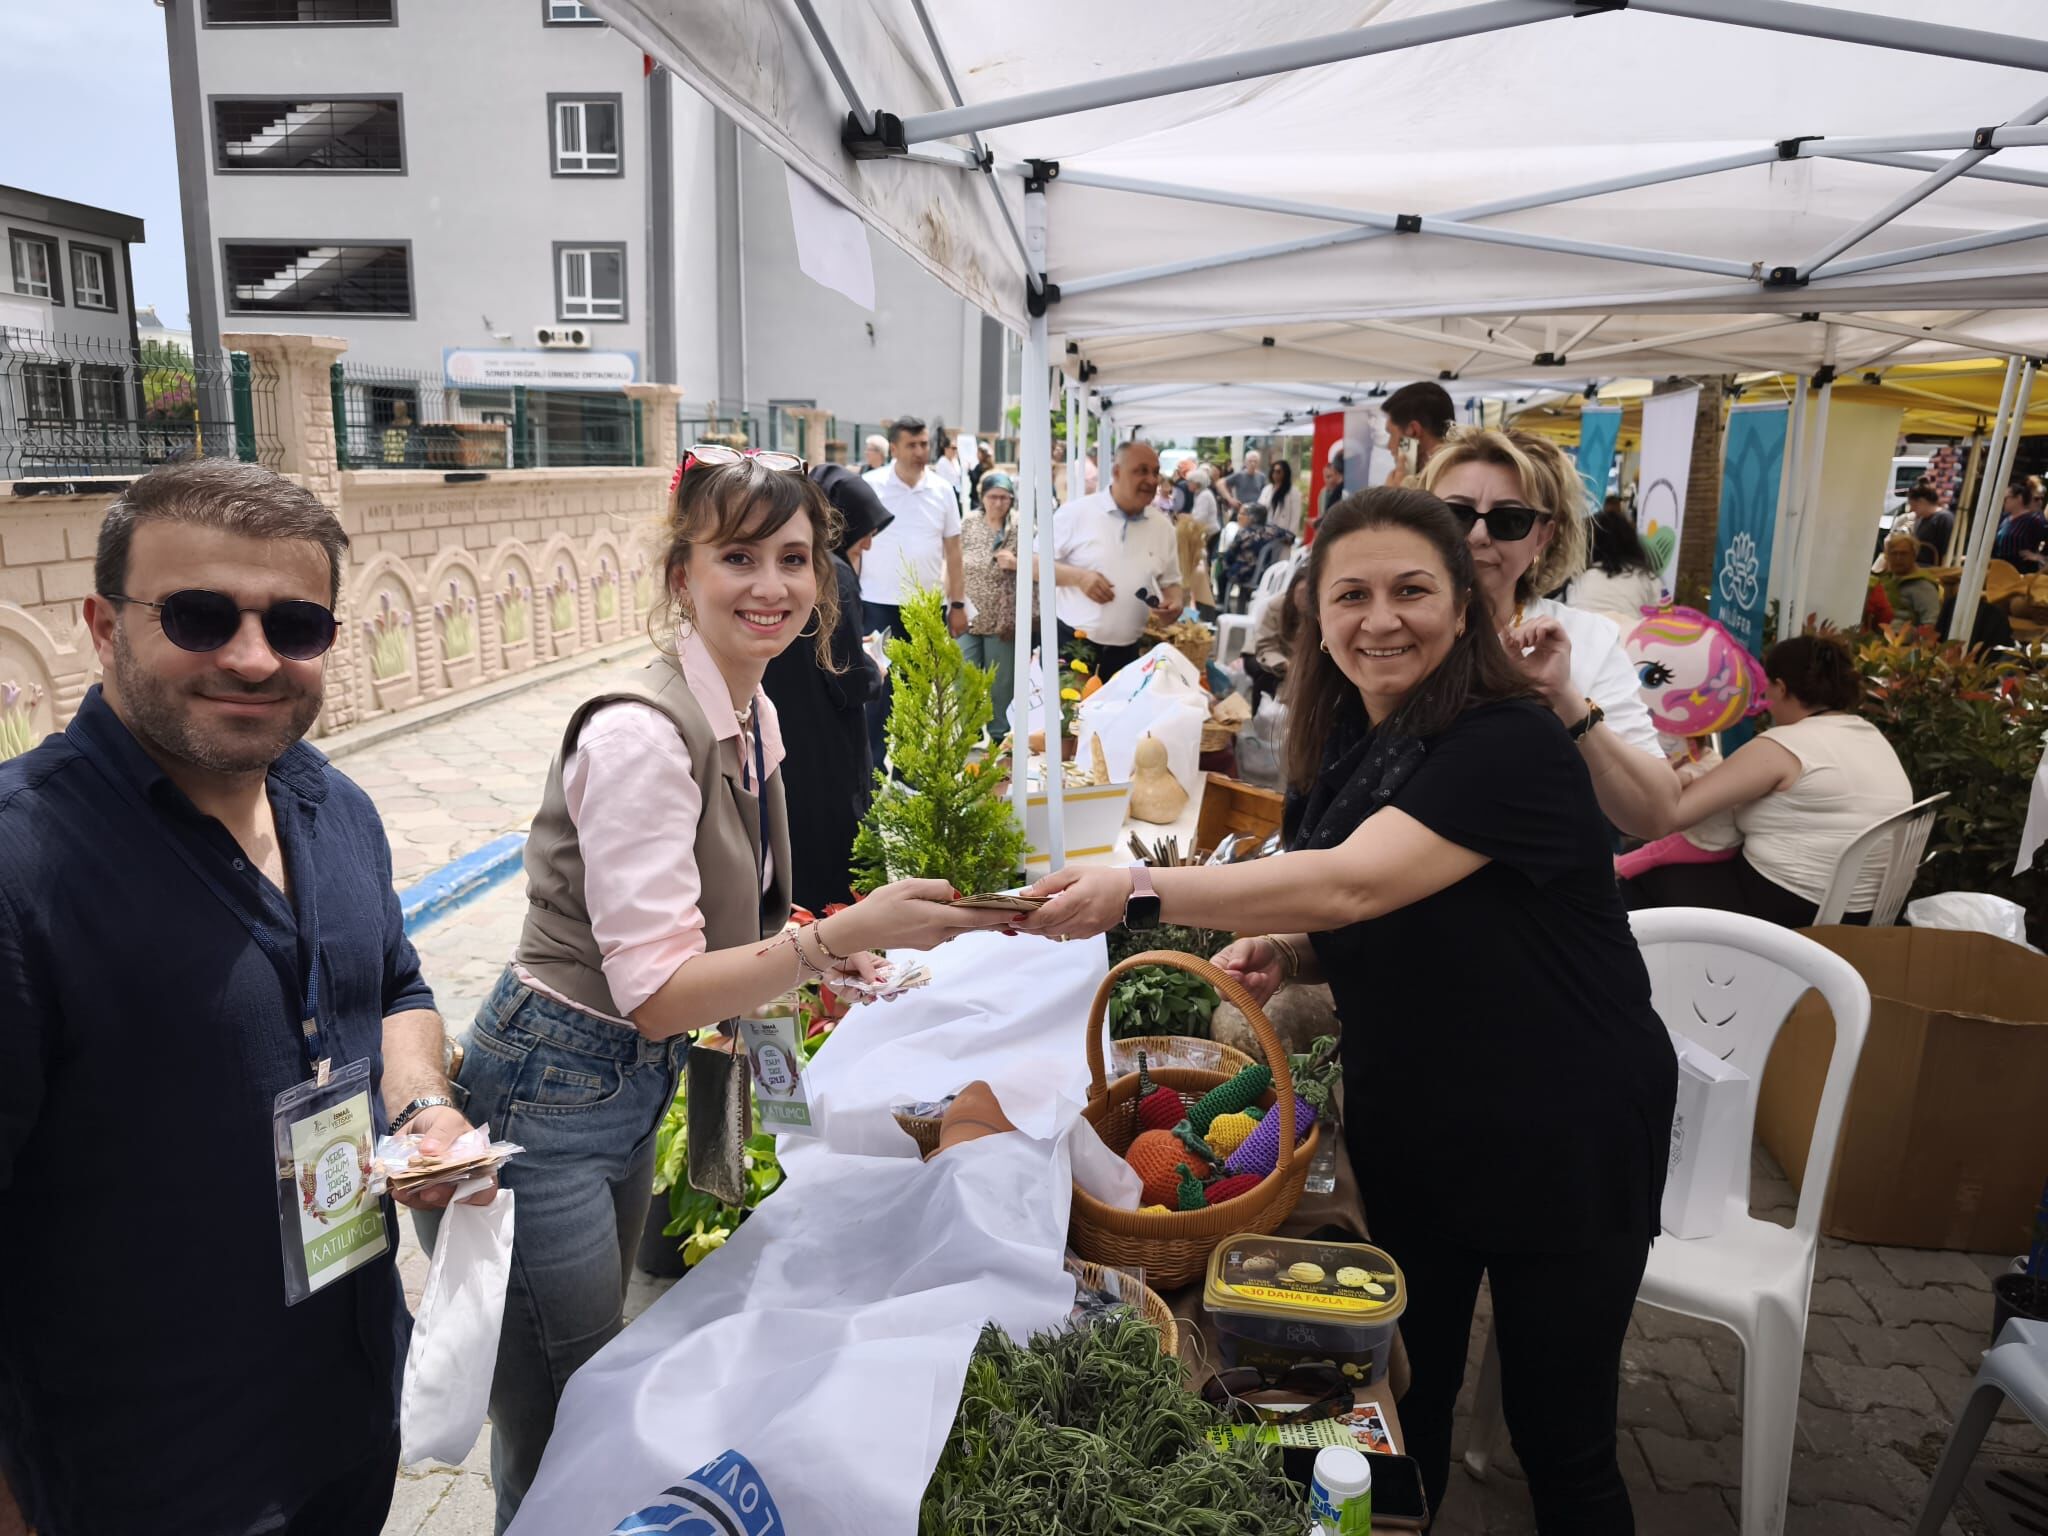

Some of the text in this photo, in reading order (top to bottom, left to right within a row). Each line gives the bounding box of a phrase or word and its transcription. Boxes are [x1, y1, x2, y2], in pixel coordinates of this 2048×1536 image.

[311, 1216, 378, 1266] KATILIMCI
[1267, 1290, 1303, 1300] DAHA
[1306, 1295, 1344, 1305] FAZLA
